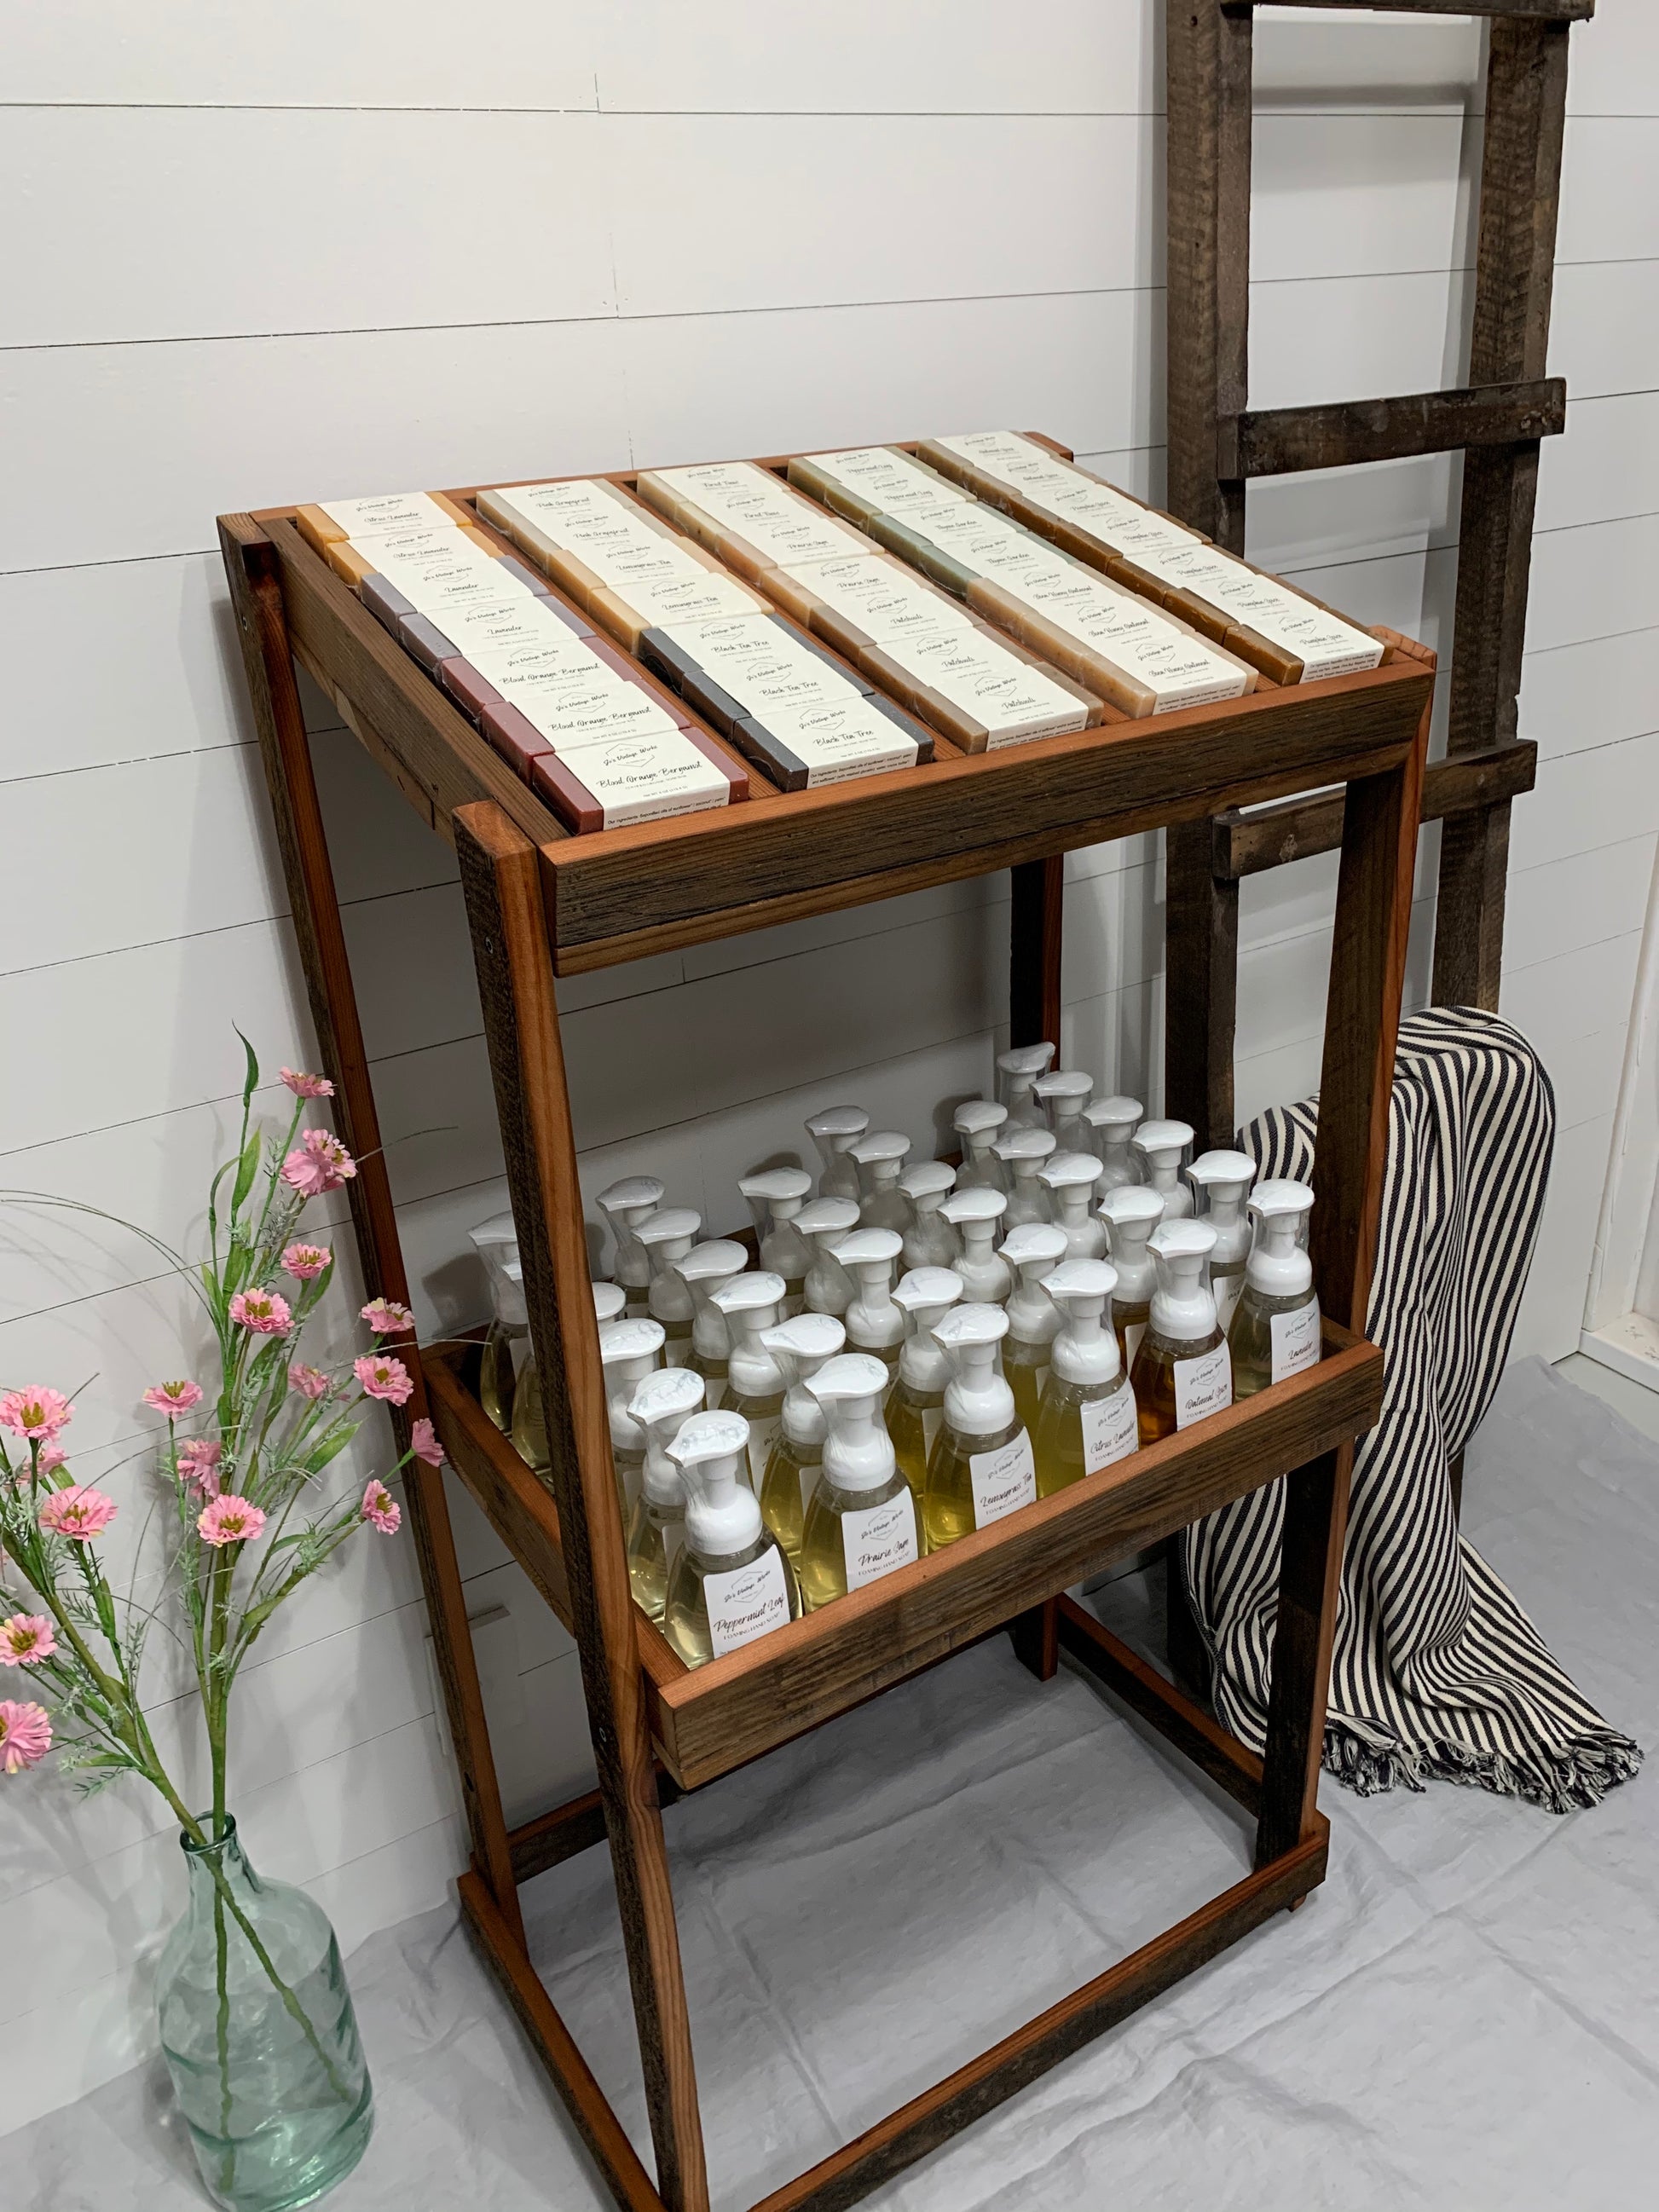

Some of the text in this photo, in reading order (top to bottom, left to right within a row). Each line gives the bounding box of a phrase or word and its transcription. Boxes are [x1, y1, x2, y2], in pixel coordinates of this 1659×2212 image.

[444, 583, 479, 592] Lavender
[487, 626, 523, 634] Lavender
[752, 639, 769, 648] Tree
[499, 663, 600, 684] Blood Orange Bergamot
[759, 686, 783, 696] Black
[785, 684, 800, 692] Tea
[1002, 698, 1036, 709] Patchouli
[548, 707, 651, 731] Blood Orange Bergamot
[812, 736, 838, 746] Black
[840, 733, 855, 742] Tea
[597, 761, 702, 788] Blood Orange Bergamot
[980, 1473, 1032, 1507] Lemongrass Tea
[858, 1538, 909, 1566] Prairie Sage
[858, 1551, 910, 1575] FOAMING HAND SOAP
[714, 1593, 784, 1632] Peppermint Leaf
[724, 1613, 780, 1640] FOAMING HAND SOAP
